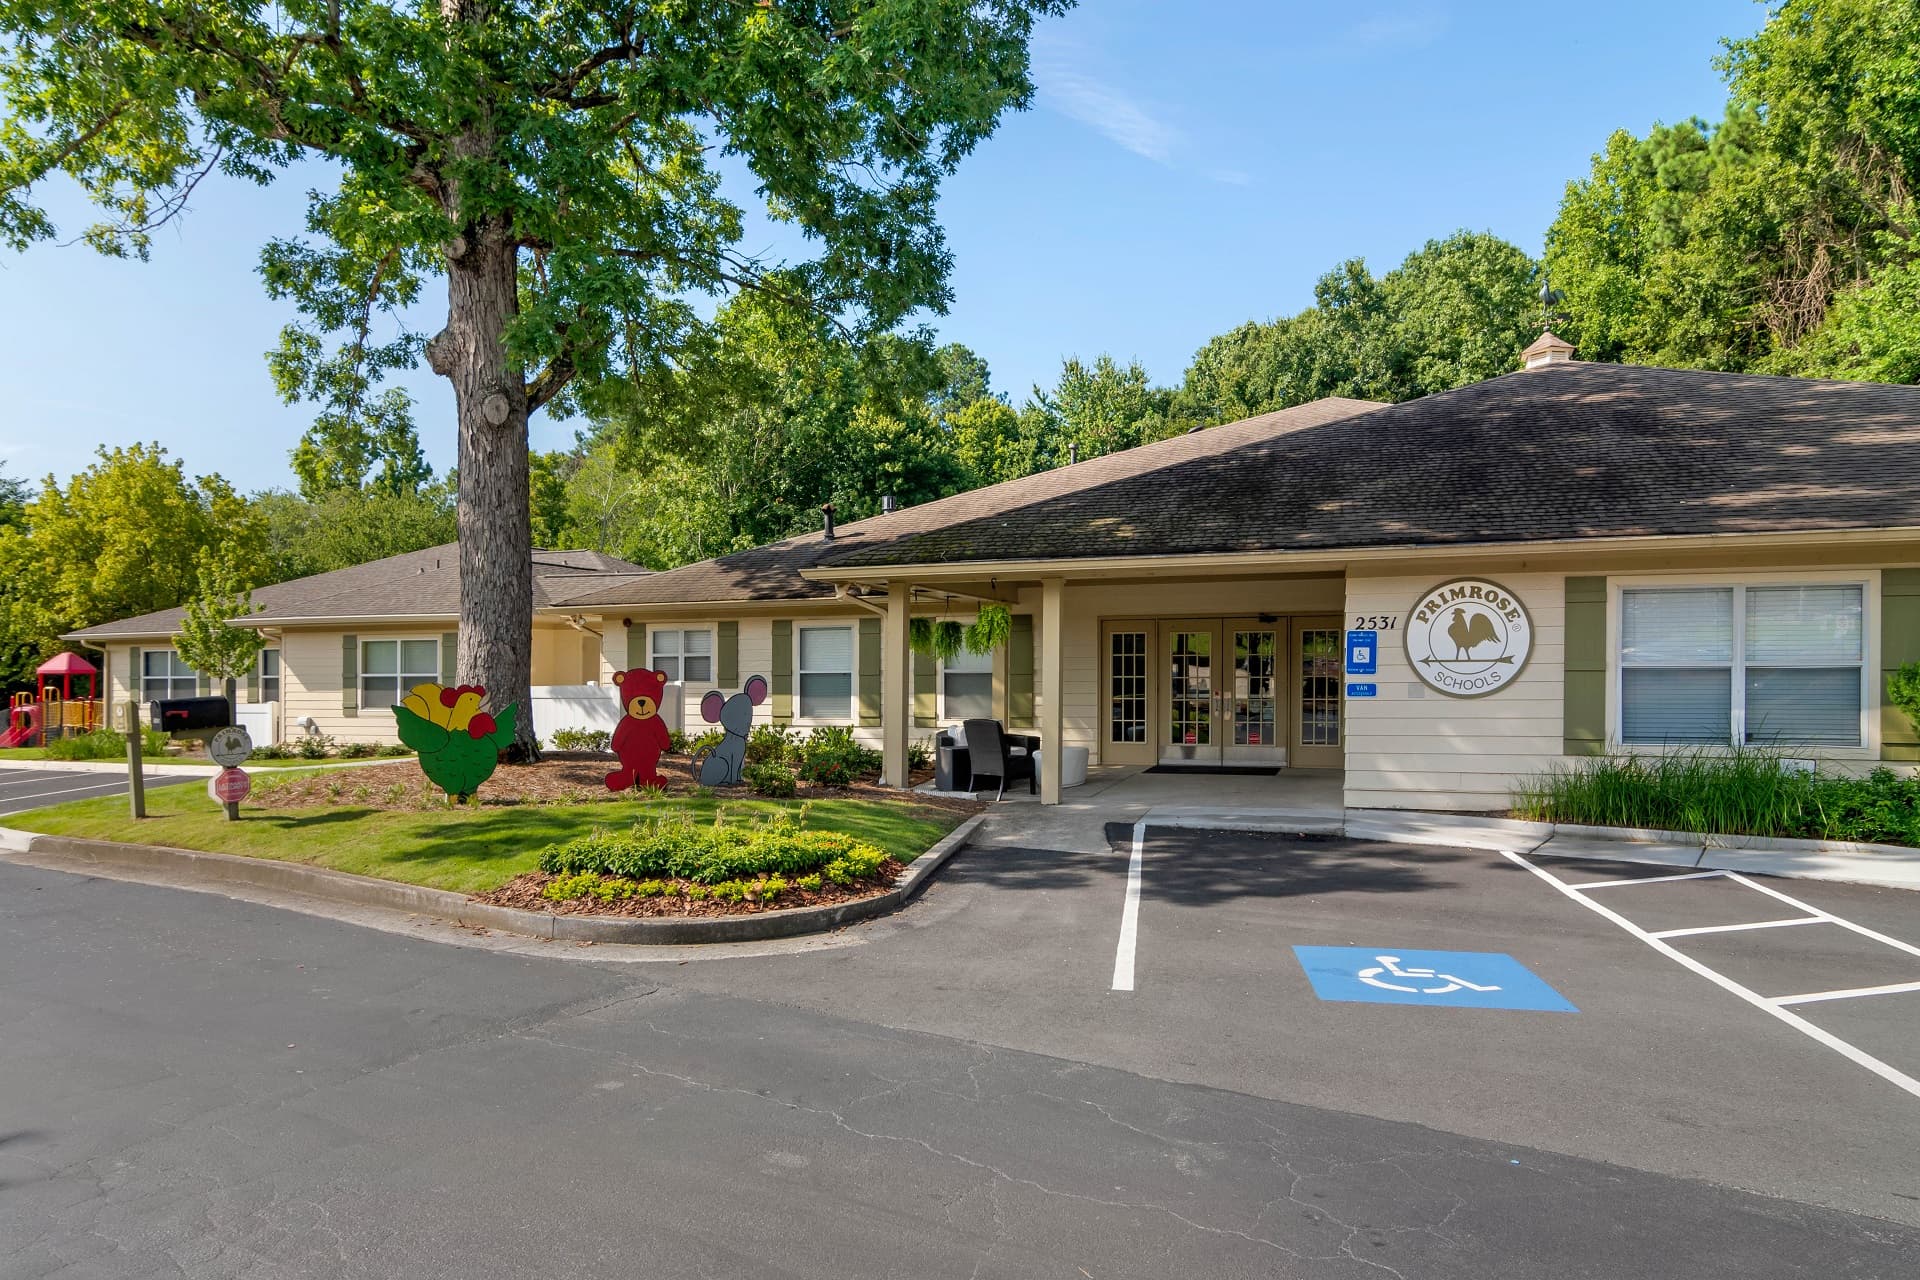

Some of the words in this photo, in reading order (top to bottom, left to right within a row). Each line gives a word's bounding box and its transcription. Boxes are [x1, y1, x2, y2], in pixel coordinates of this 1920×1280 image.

[1416, 585, 1521, 624] PRIMROSE
[1355, 616, 1397, 630] 2531
[1434, 671, 1502, 690] SCHOOLS
